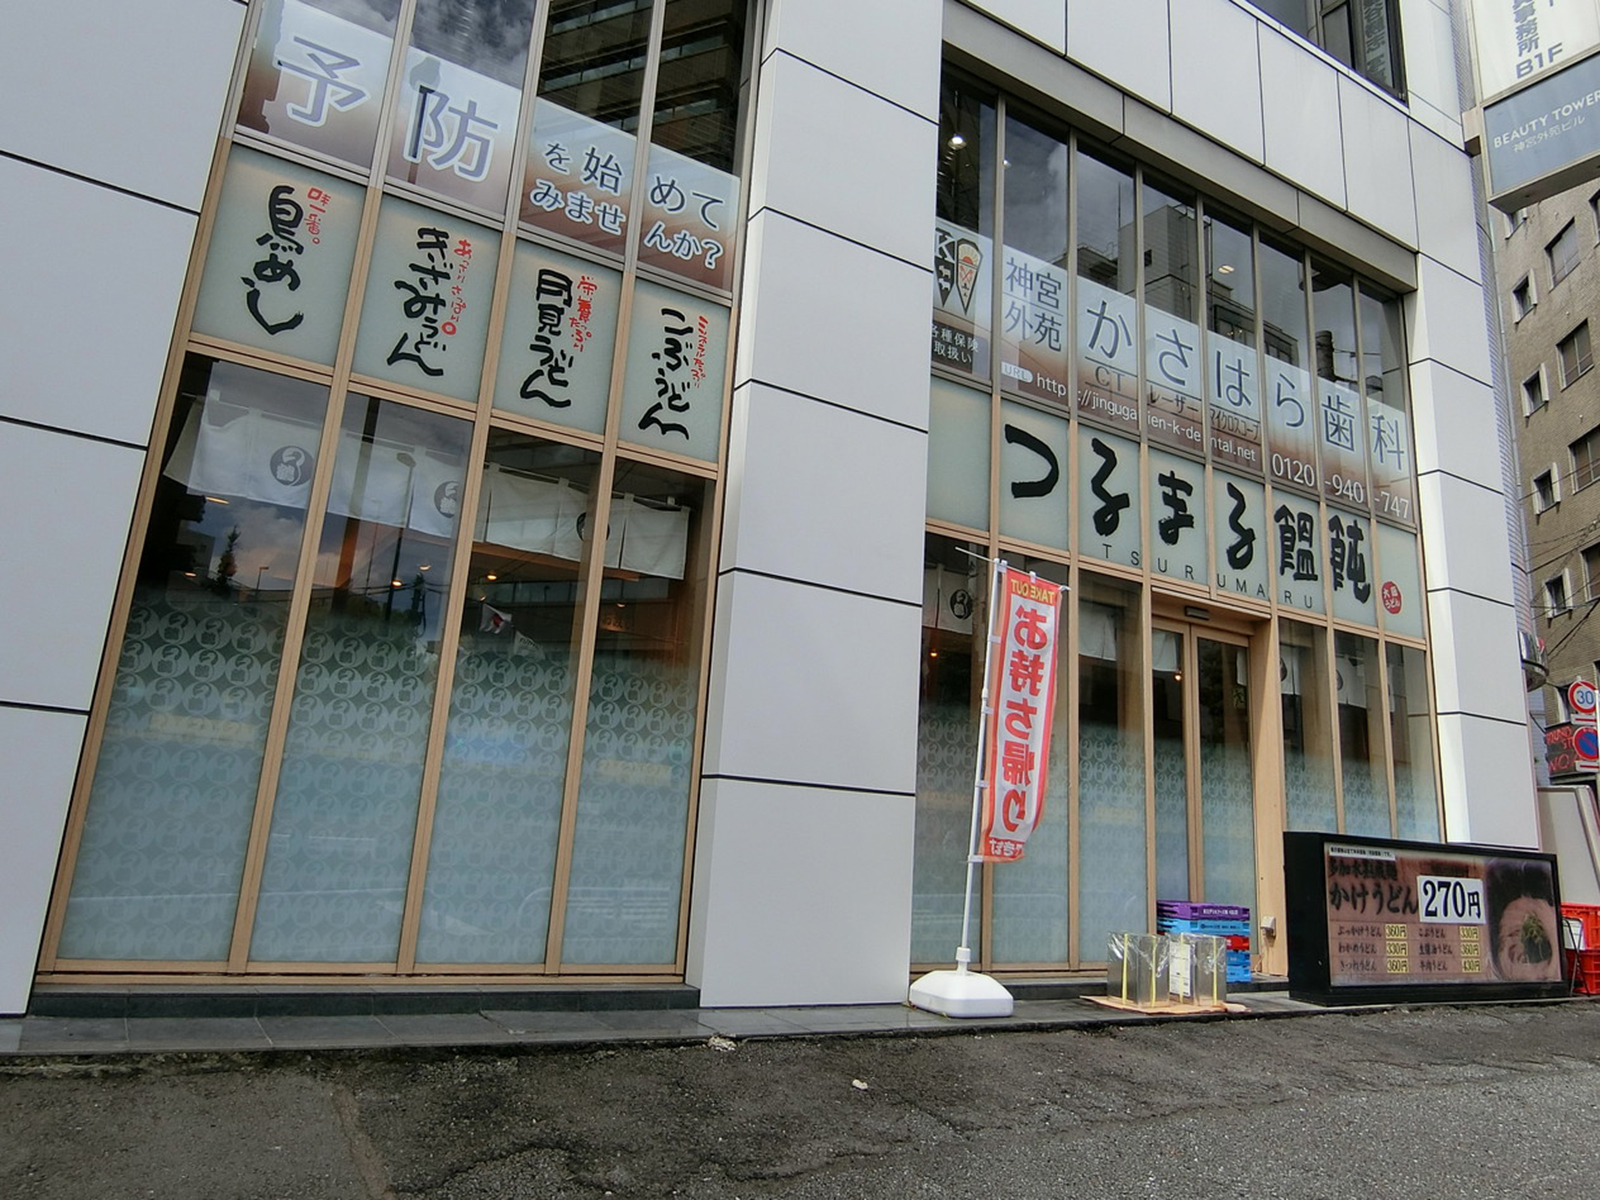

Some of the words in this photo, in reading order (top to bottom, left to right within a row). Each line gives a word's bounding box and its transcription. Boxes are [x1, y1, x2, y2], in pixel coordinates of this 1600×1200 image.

[1516, 42, 1563, 79] B1F
[277, 36, 499, 180] 予防
[1494, 115, 1549, 148] BEAUTY
[1552, 90, 1600, 121] TOWER
[544, 142, 724, 229] を始めて
[240, 185, 304, 335] 鳥めし
[1005, 257, 1062, 310] 神宮
[387, 227, 453, 377] きざみうどん
[1004, 300, 1062, 352] 外苑
[520, 269, 573, 408] 月見うどん
[933, 341, 972, 363] 取扱い
[638, 308, 694, 440] こぶうどん
[1004, 368, 1029, 381] URL
[1086, 300, 1405, 471] かさはら歯科
[1095, 365, 1126, 392] CT
[1104, 543, 1314, 610] TSURUMARU
[1576, 690, 1595, 705] 30
[1329, 882, 1418, 915] かけうどん
[1423, 879, 1482, 919] 270円
